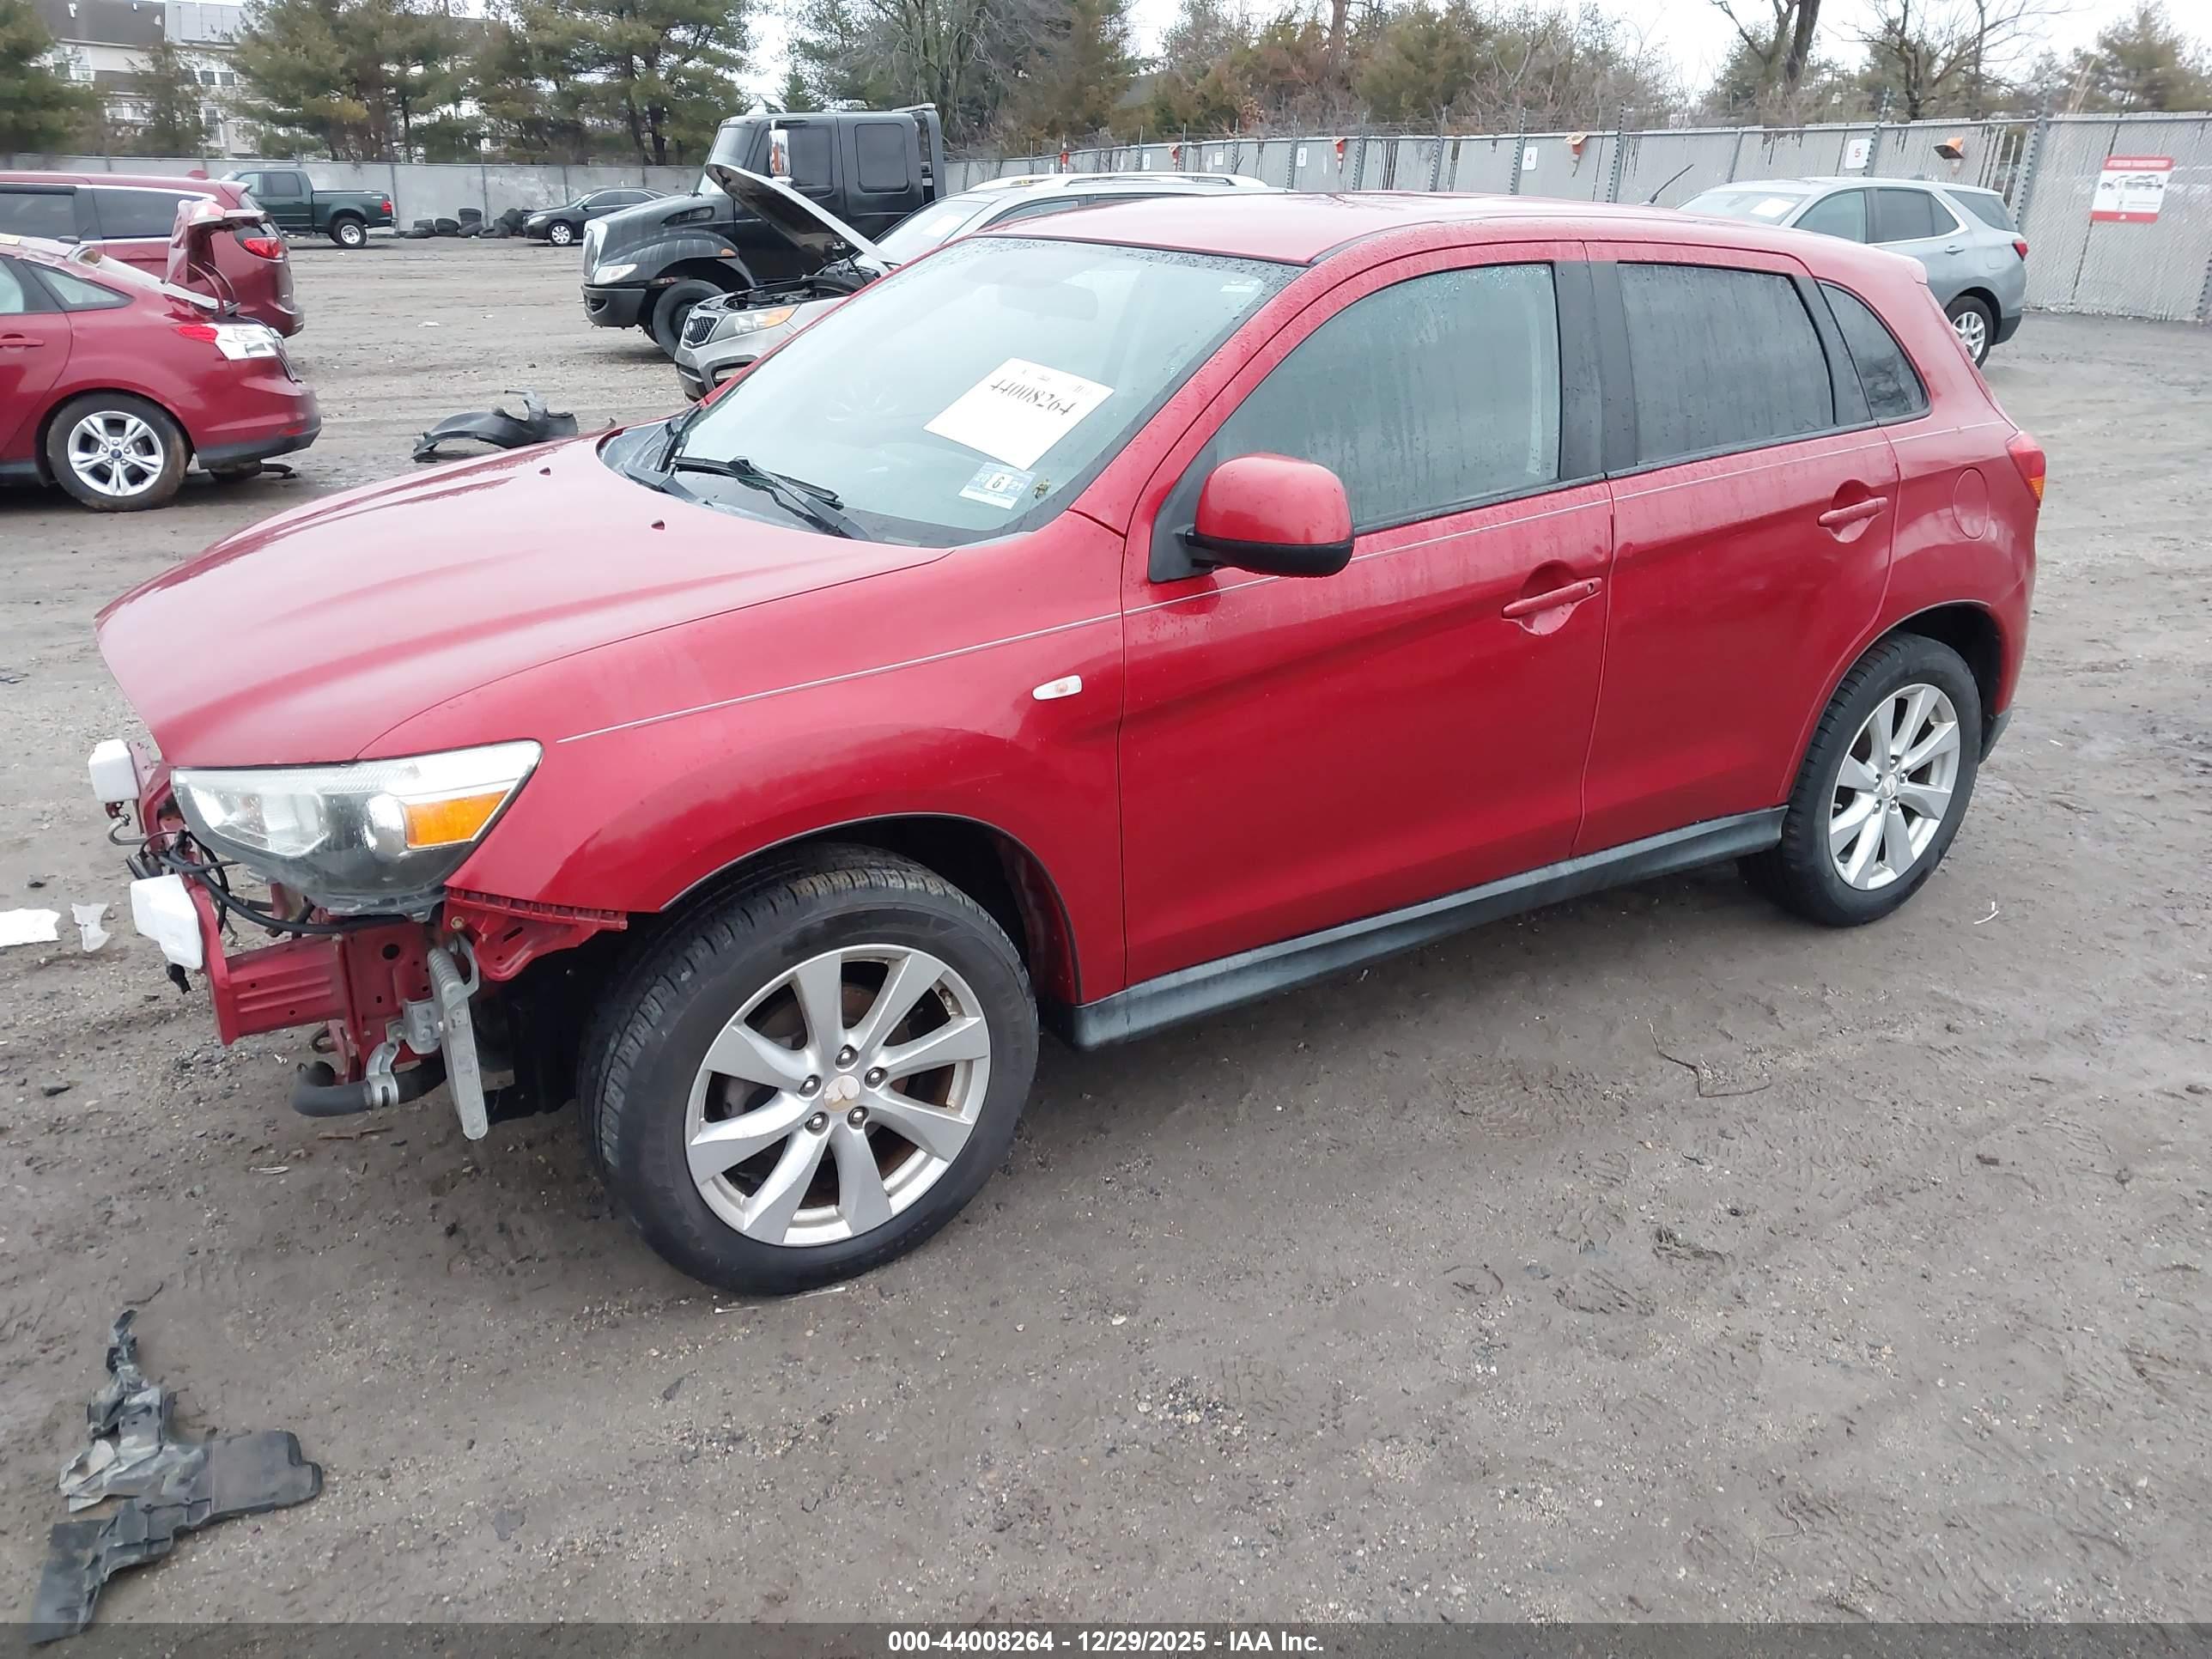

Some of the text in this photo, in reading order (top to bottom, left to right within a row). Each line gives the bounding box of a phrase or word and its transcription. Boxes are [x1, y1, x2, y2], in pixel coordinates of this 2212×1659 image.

[1854, 148, 1862, 158] 5
[990, 379, 1077, 415] 44008264
[975, 472, 990, 483] 20
